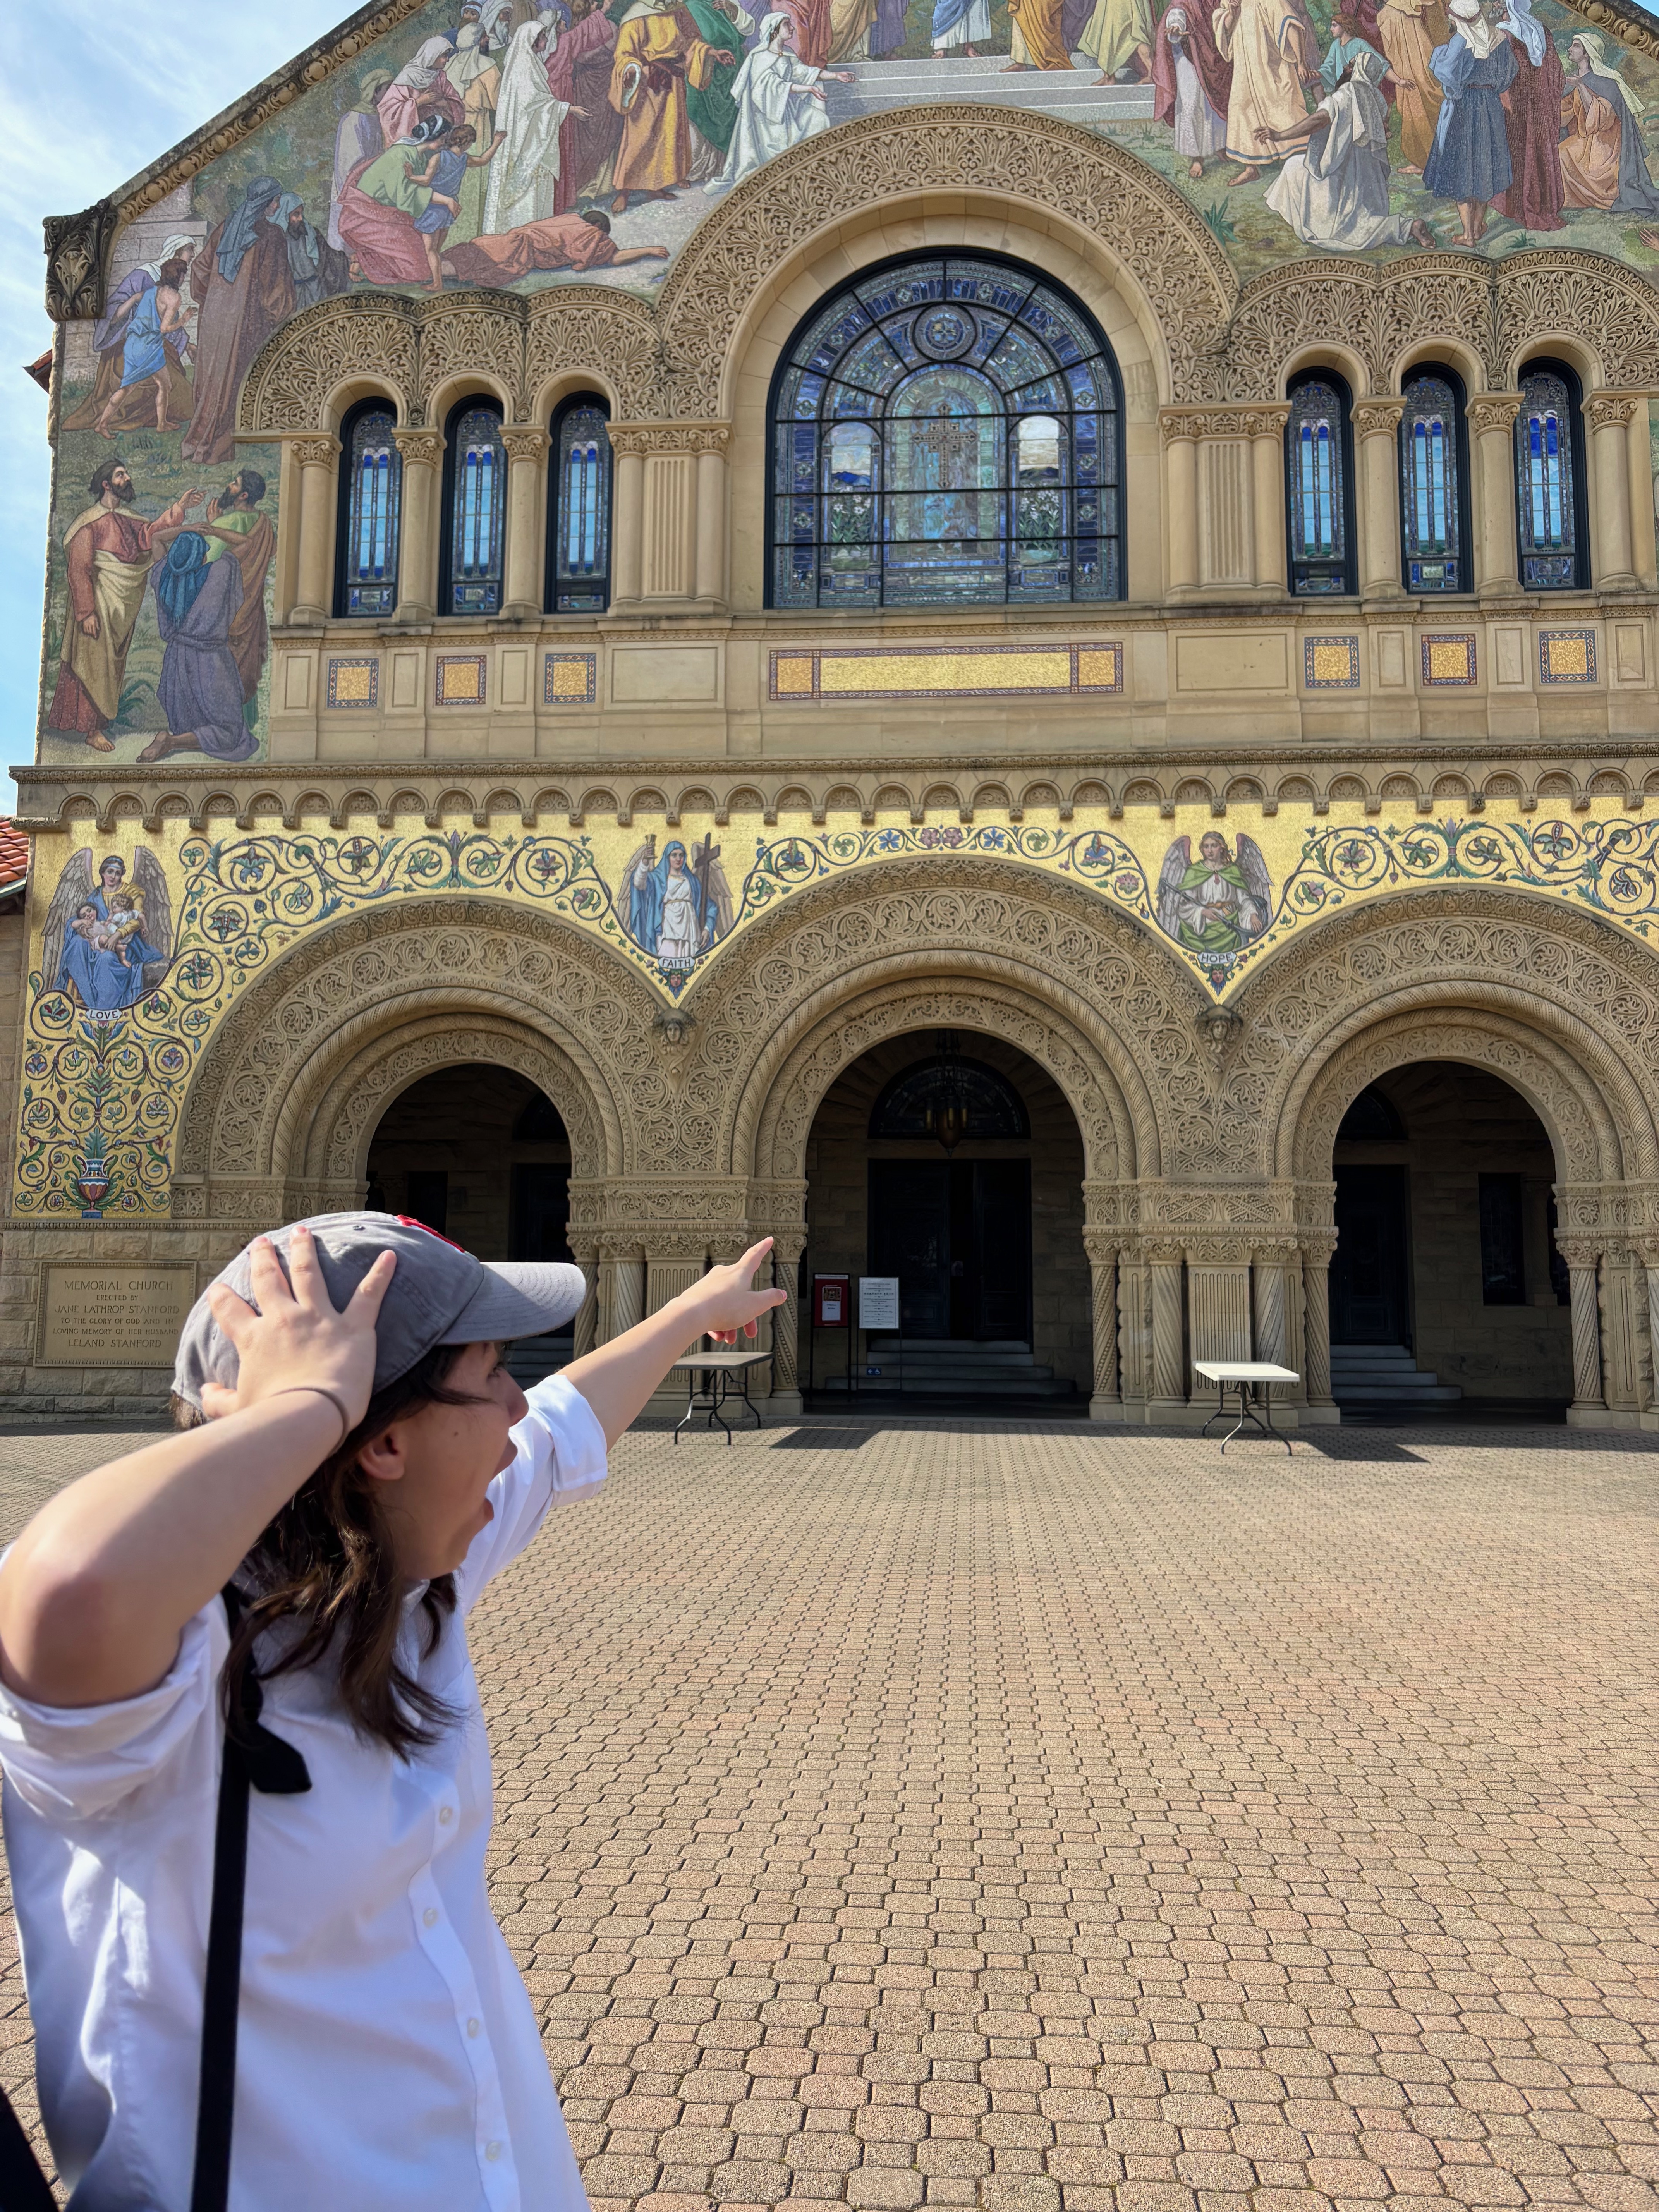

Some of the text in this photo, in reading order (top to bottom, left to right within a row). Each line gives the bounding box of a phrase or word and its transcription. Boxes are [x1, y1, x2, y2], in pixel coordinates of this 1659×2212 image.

[1201, 953, 1233, 962] HOPE
[662, 959, 690, 967] FAITH
[90, 1010, 118, 1019] LOVE
[64, 1280, 173, 1290] MEMORIAL CHURCH
[84, 1305, 124, 1314] LATHROP
[129, 1305, 180, 1314] STANFORD
[111, 1339, 161, 1348] STANFORD
